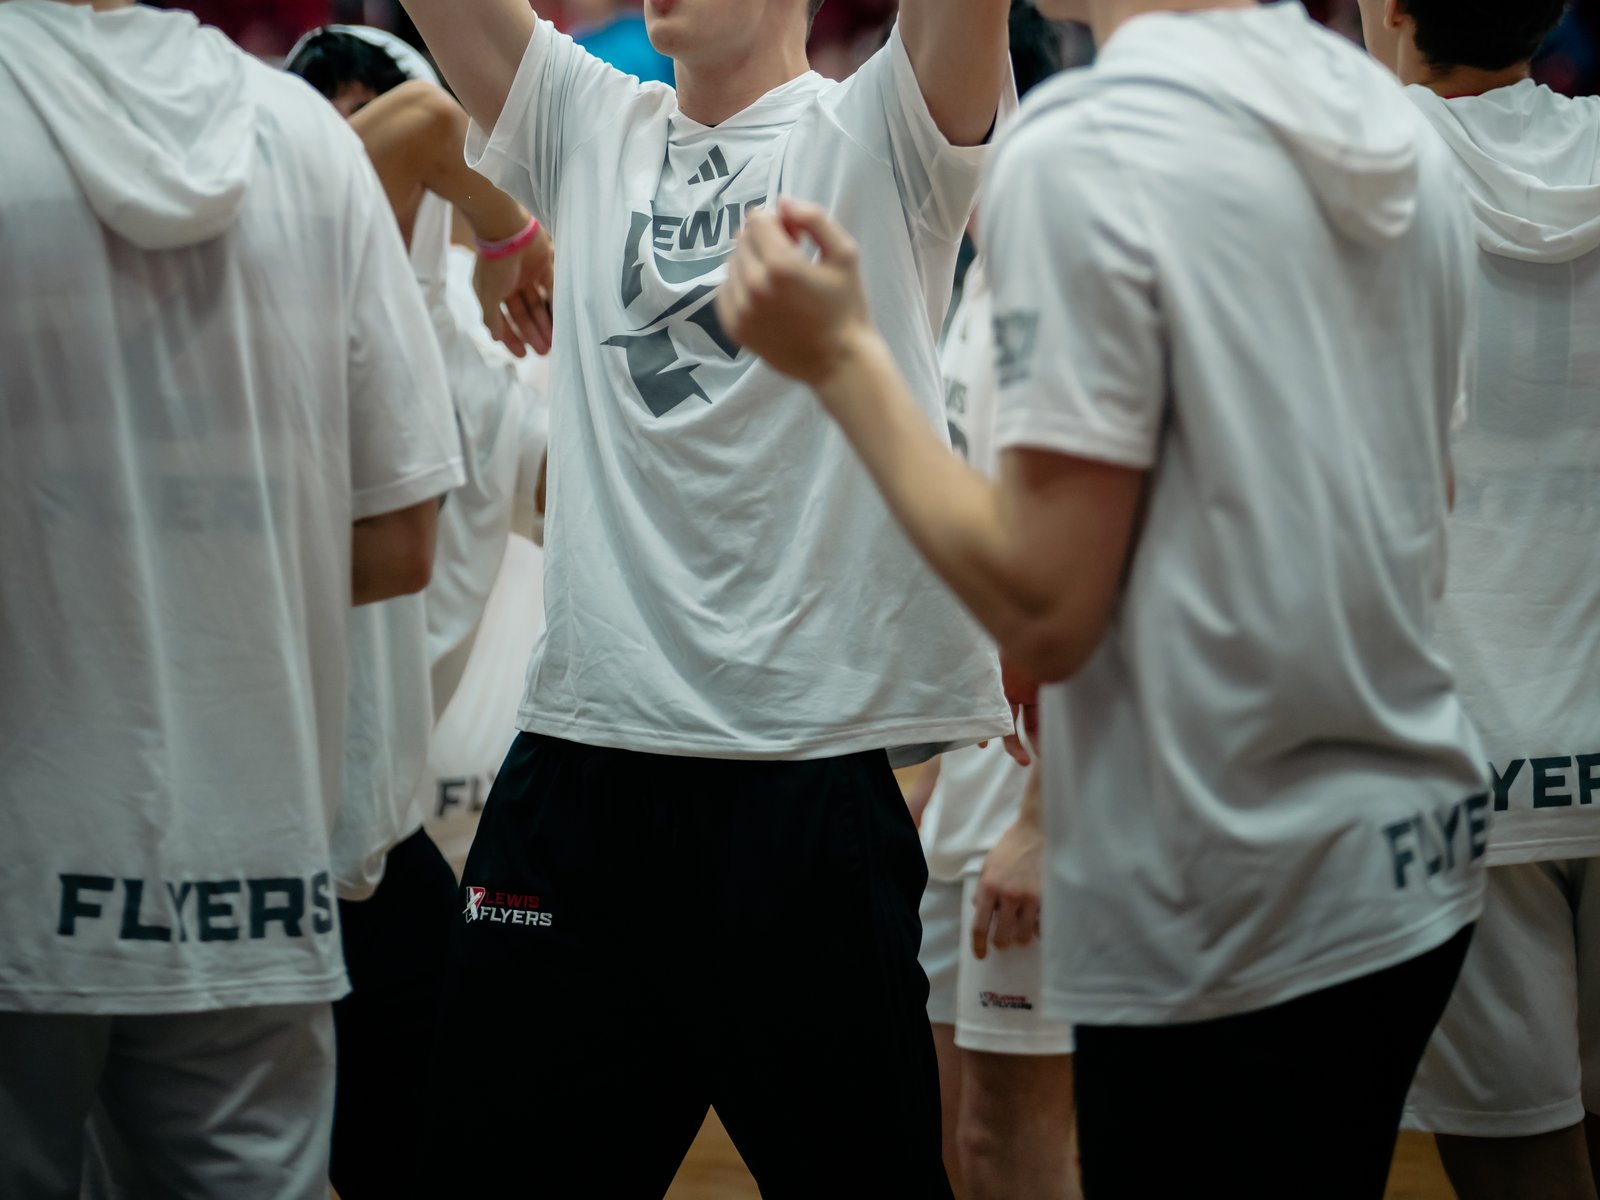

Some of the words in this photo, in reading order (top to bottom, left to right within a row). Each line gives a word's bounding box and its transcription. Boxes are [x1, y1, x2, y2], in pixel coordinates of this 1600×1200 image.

[649, 195, 767, 252] EWI
[57, 872, 333, 942] FLYERS
[479, 906, 553, 927] FLYERS
[485, 891, 540, 909] LEWIS
